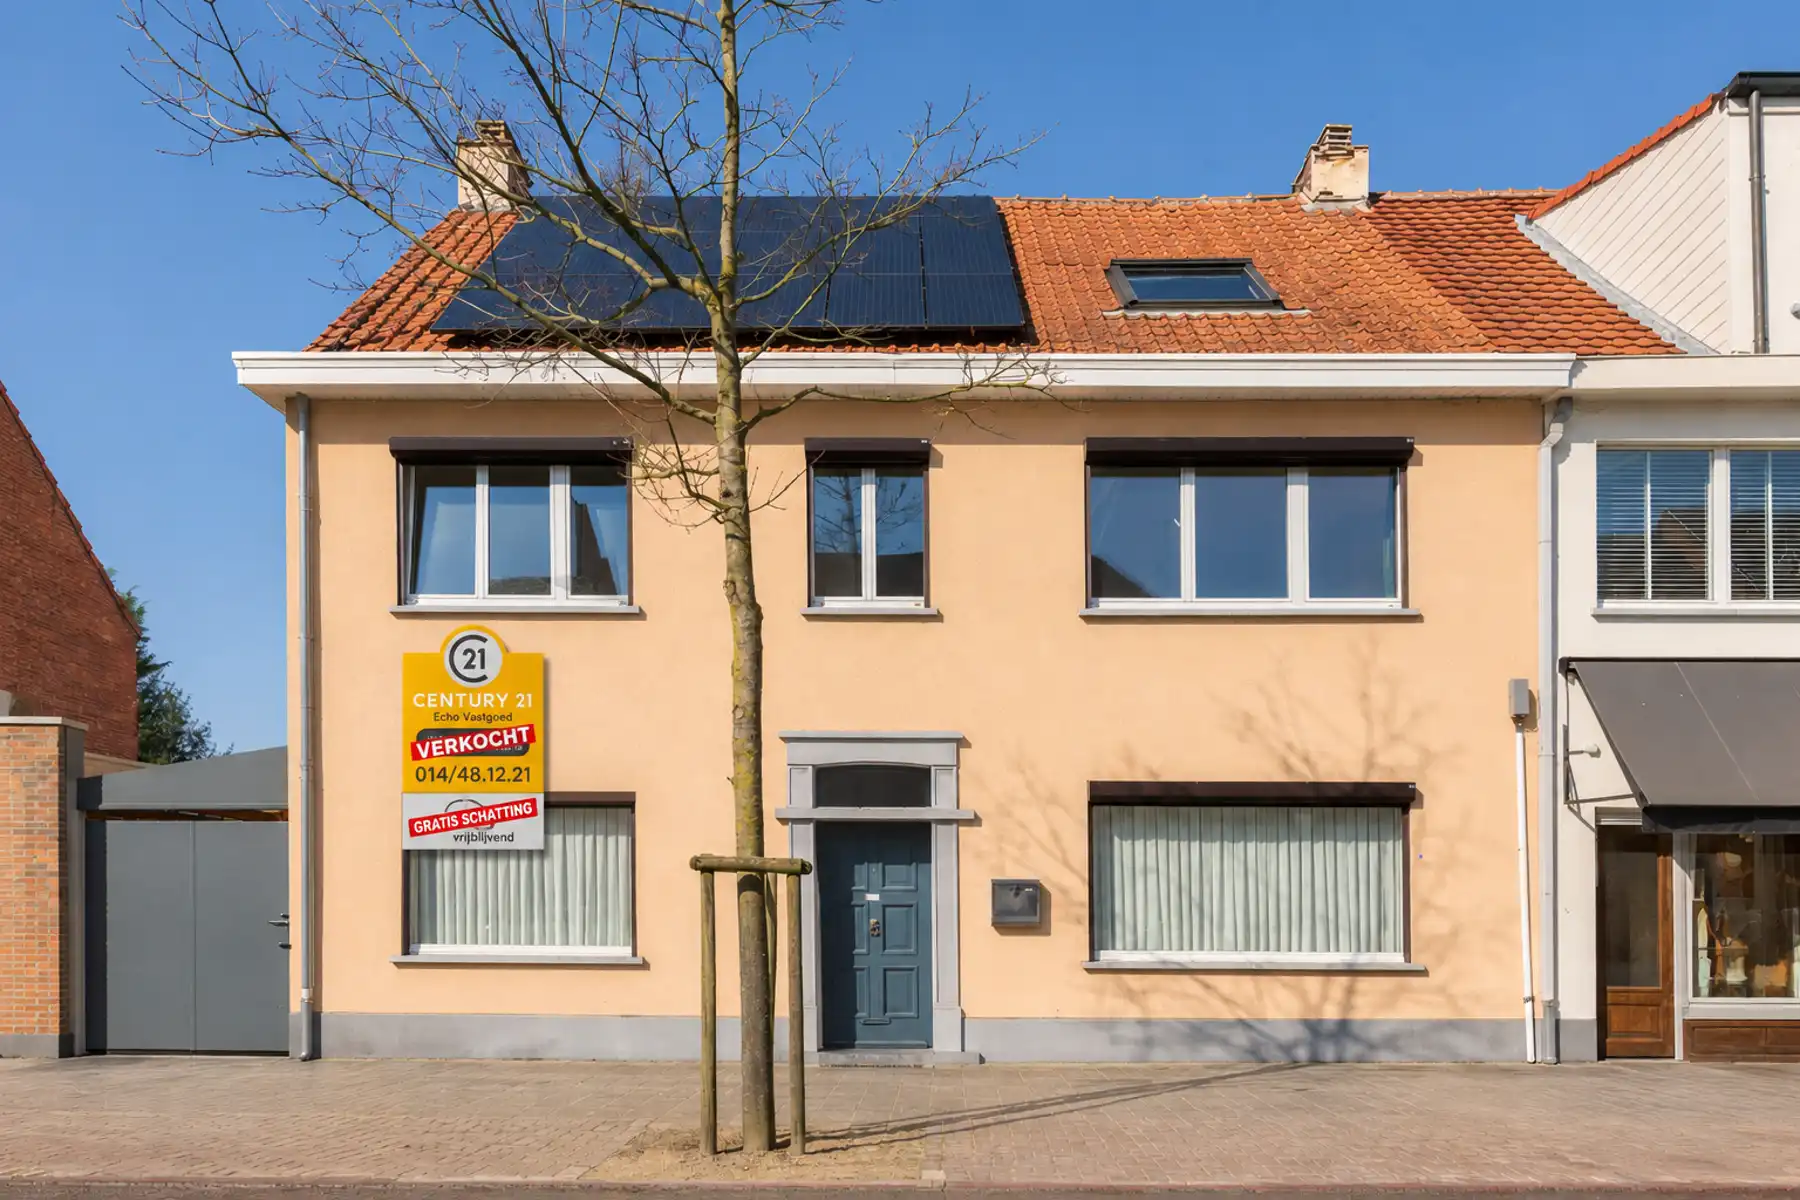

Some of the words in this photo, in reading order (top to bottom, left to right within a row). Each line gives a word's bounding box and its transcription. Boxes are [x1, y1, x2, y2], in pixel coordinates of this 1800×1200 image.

[413, 693, 508, 708] CENTURY
[516, 693, 533, 708] 21
[433, 712, 460, 722] Echo
[463, 712, 512, 724] Vastgoed
[416, 726, 530, 758] VERKOCHT
[415, 765, 531, 784] 014/48.12.21
[414, 815, 459, 833] GRATIS
[462, 802, 533, 825] SCHATTING
[453, 832, 514, 845] vrijblijvend
